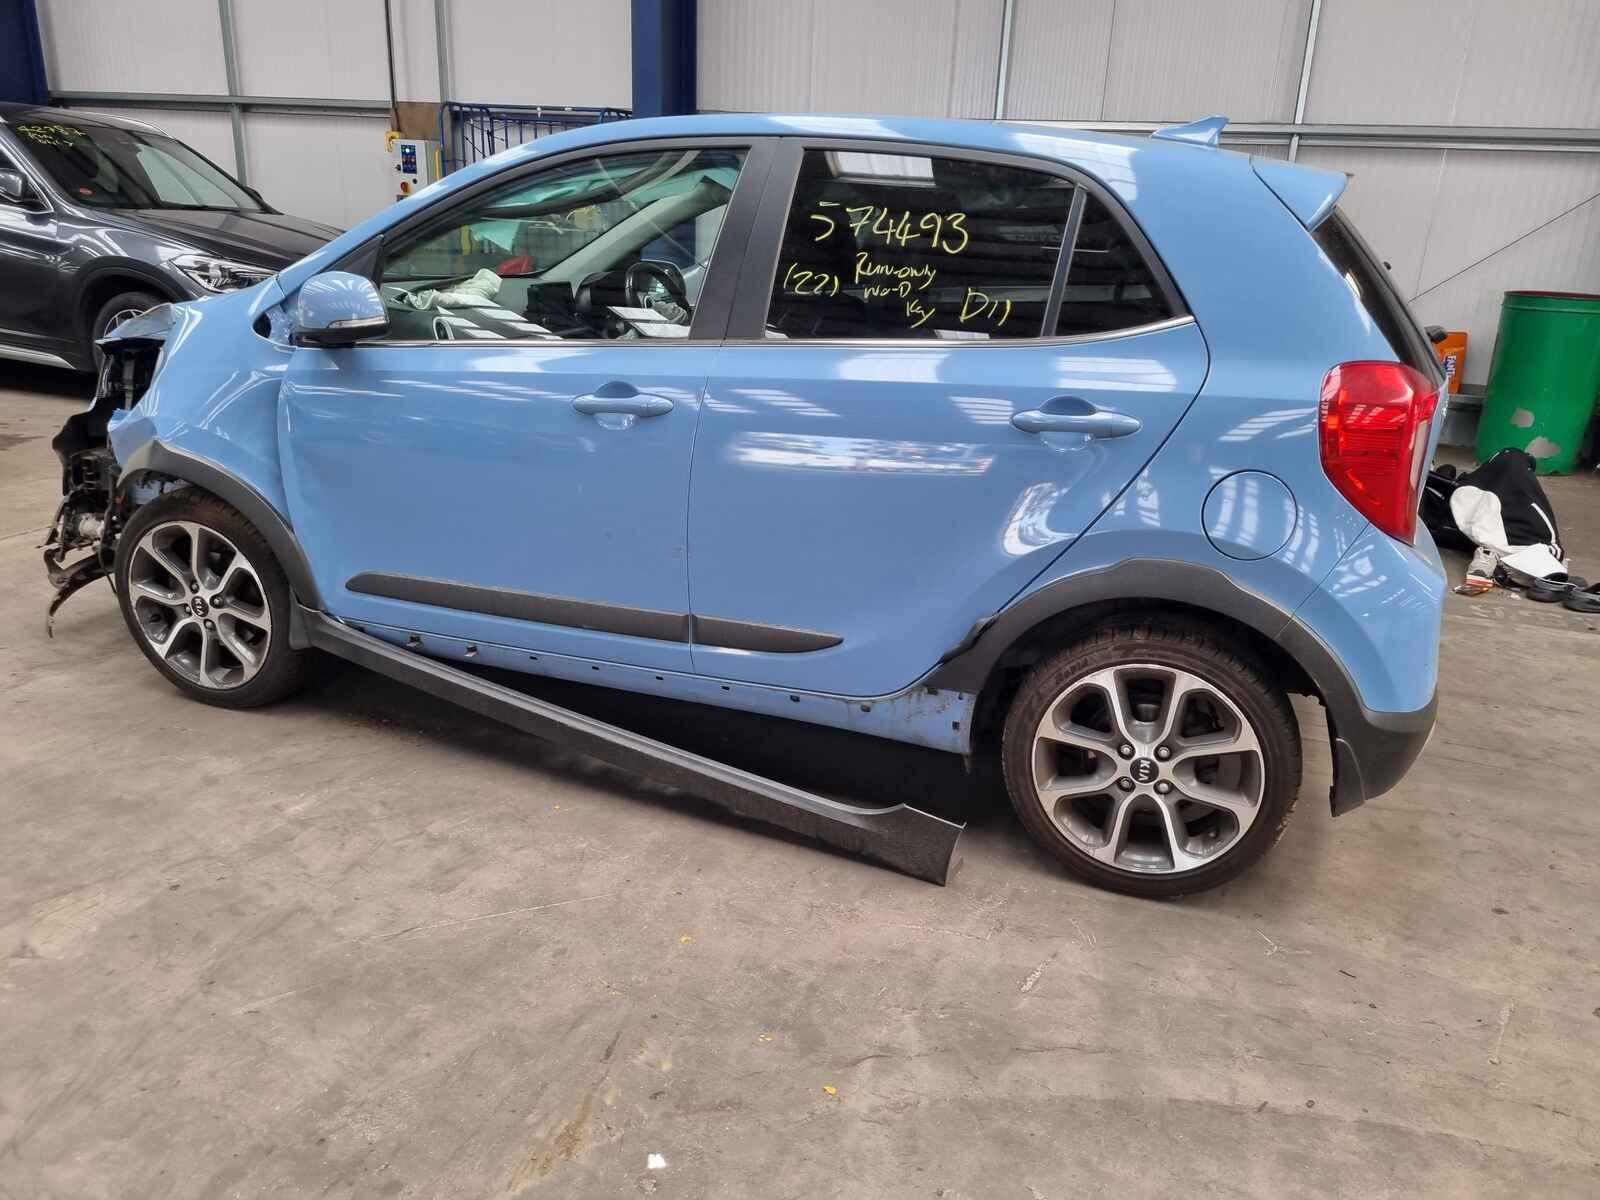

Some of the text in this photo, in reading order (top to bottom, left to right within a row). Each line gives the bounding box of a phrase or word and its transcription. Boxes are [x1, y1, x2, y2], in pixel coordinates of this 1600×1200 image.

[810, 200, 969, 254] 574493
[1445, 354, 1457, 378] FANT
[1139, 759, 1151, 781] KIA
